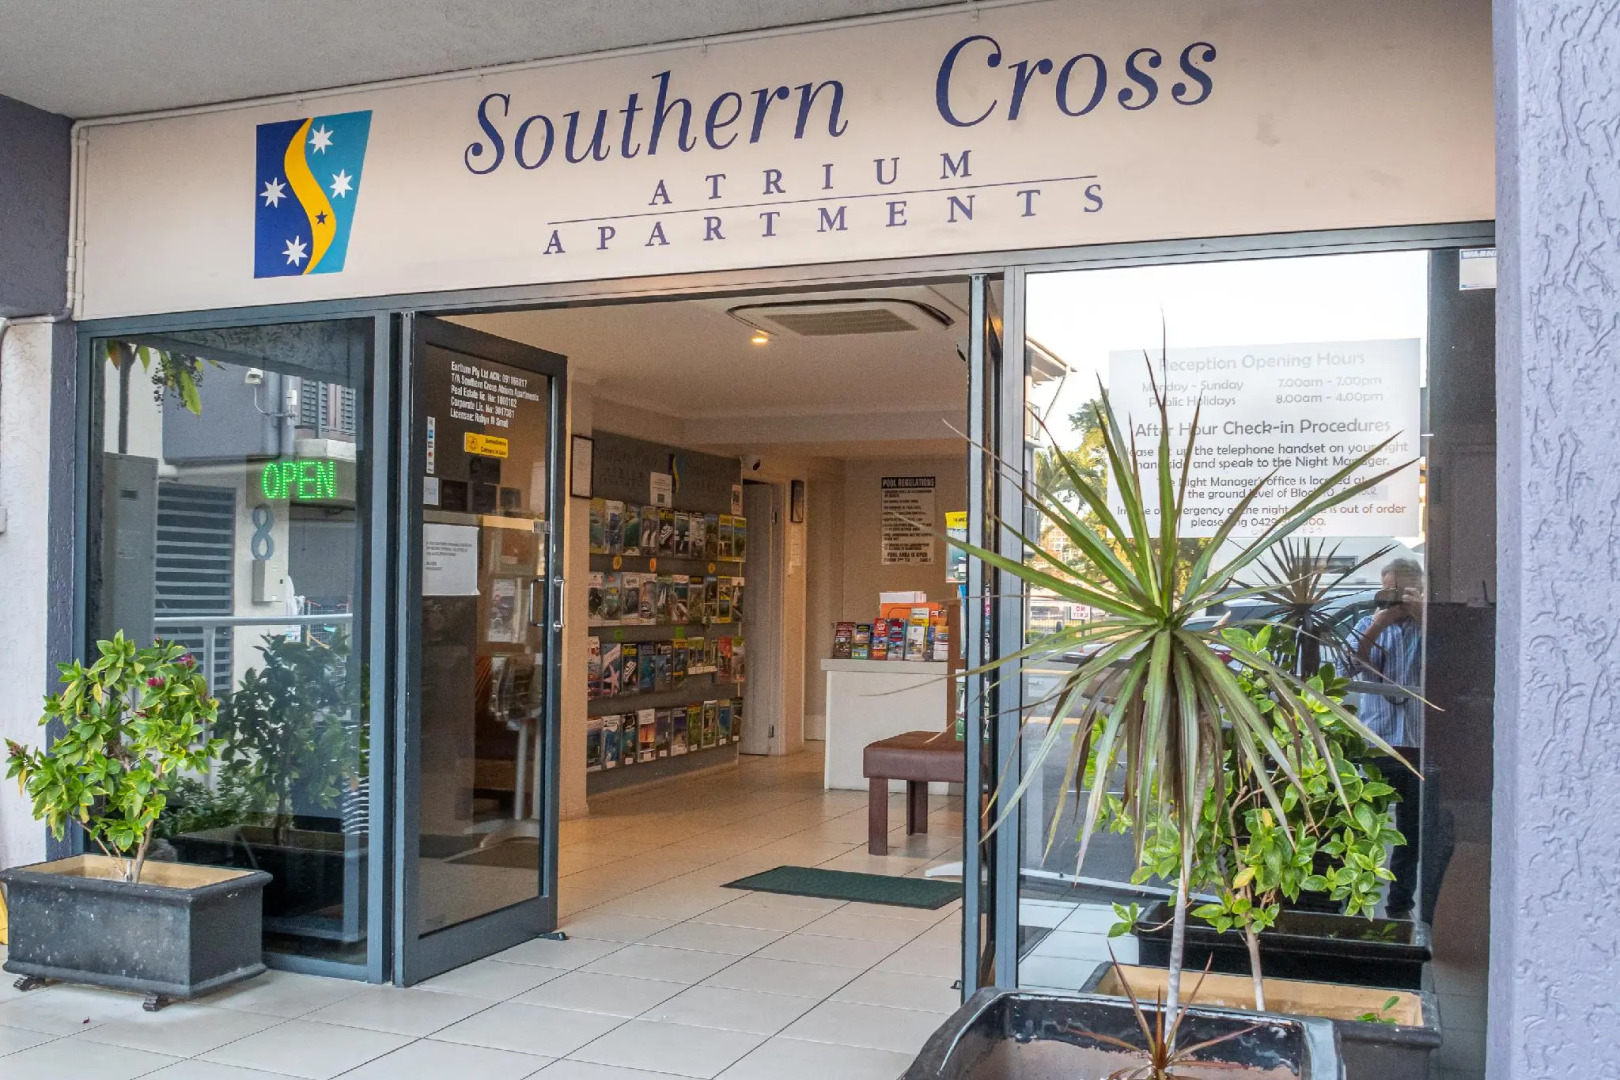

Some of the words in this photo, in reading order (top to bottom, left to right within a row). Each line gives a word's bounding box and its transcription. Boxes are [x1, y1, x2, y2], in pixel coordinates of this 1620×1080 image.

[464, 69, 849, 175] Southern
[935, 34, 1217, 128] Cross
[648, 150, 973, 206] ATRIUM
[542, 183, 1104, 255] APARTMENTS
[1463, 249, 1497, 258] WARN
[1159, 356, 1237, 374] Reception
[1242, 354, 1312, 370] Opening
[1317, 351, 1366, 366] Hours
[484, 380, 498, 392] Cross
[1201, 379, 1243, 392] Sunday
[1278, 378, 1323, 388] 7.00am
[1336, 376, 1382, 388] 7.00pm
[463, 387, 478, 399] Estate
[1149, 396, 1184, 407] Pblic
[1276, 393, 1323, 404] 8.00am
[1336, 392, 1384, 403] 4.00pm
[1135, 422, 1174, 437] Aftr
[1223, 419, 1294, 436] Check-in
[1300, 417, 1391, 434] Procedures
[1194, 445, 1213, 456] the
[1217, 444, 1274, 457] telephone
[1278, 443, 1326, 455] handset
[1329, 444, 1344, 453] on
[1382, 441, 1409, 454] ight
[1193, 458, 1215, 469] and
[1219, 457, 1253, 470] speak
[1257, 458, 1269, 468] to
[1272, 456, 1291, 467] the
[1295, 456, 1328, 468] Night
[1332, 455, 1390, 468] Maager.
[262, 460, 337, 499] OPEN
[1179, 476, 1207, 488] ight
[1266, 475, 1296, 486] office
[1299, 475, 1307, 485] is
[1188, 489, 1205, 499] the
[1208, 488, 1245, 500] ground
[1249, 488, 1274, 498] evel
[1276, 488, 1288, 498] of
[1290, 487, 1316, 498] Bloc
[1182, 506, 1224, 517] ergency
[1262, 504, 1289, 515] night
[1329, 505, 1337, 514] is
[1340, 504, 1359, 514] out
[1362, 503, 1374, 514] of
[1376, 503, 1406, 514] order
